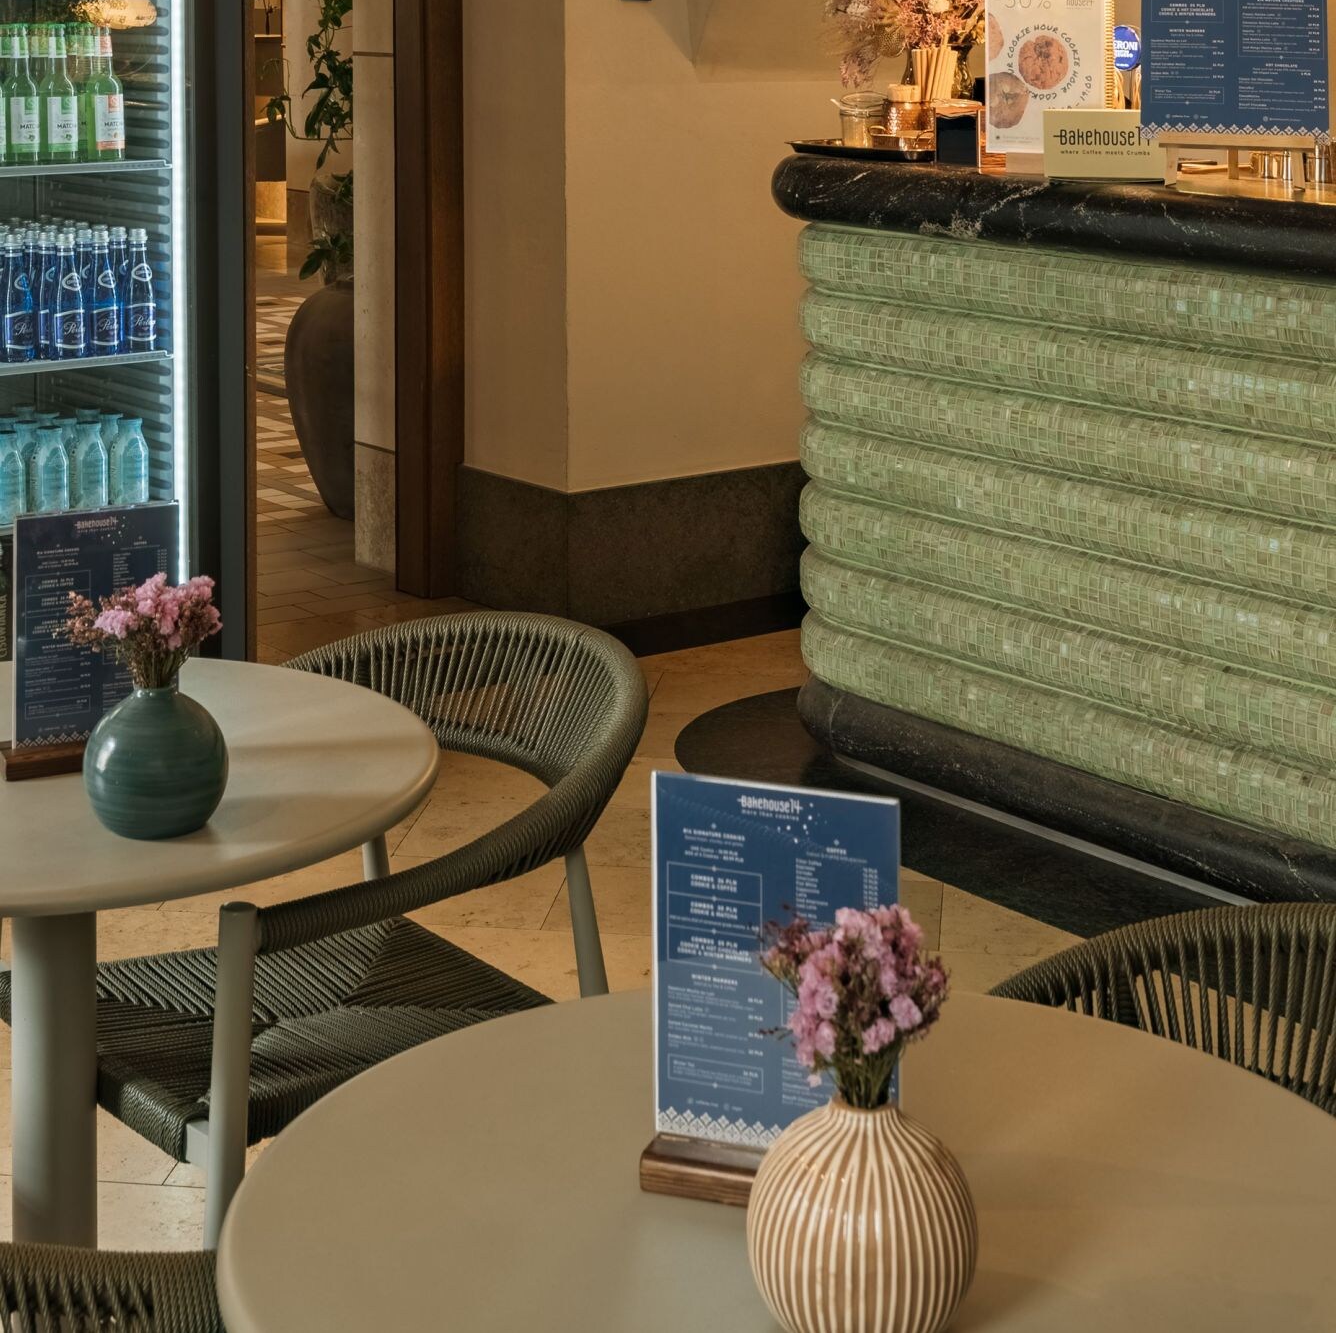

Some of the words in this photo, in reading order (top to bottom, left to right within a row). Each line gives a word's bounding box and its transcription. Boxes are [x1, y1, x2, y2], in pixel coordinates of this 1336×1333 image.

[1034, 24, 1058, 34] HOUR
[1008, 27, 1031, 59] COOKIE
[1061, 32, 1081, 67] COOKIE
[1113, 40, 1138, 51] ERONI
[1061, 71, 1079, 93] HOUR
[1027, 89, 1057, 101] COOK
[1053, 126, 1150, 146] Bakehouse1
[737, 795, 803, 815] Bakehouse14
